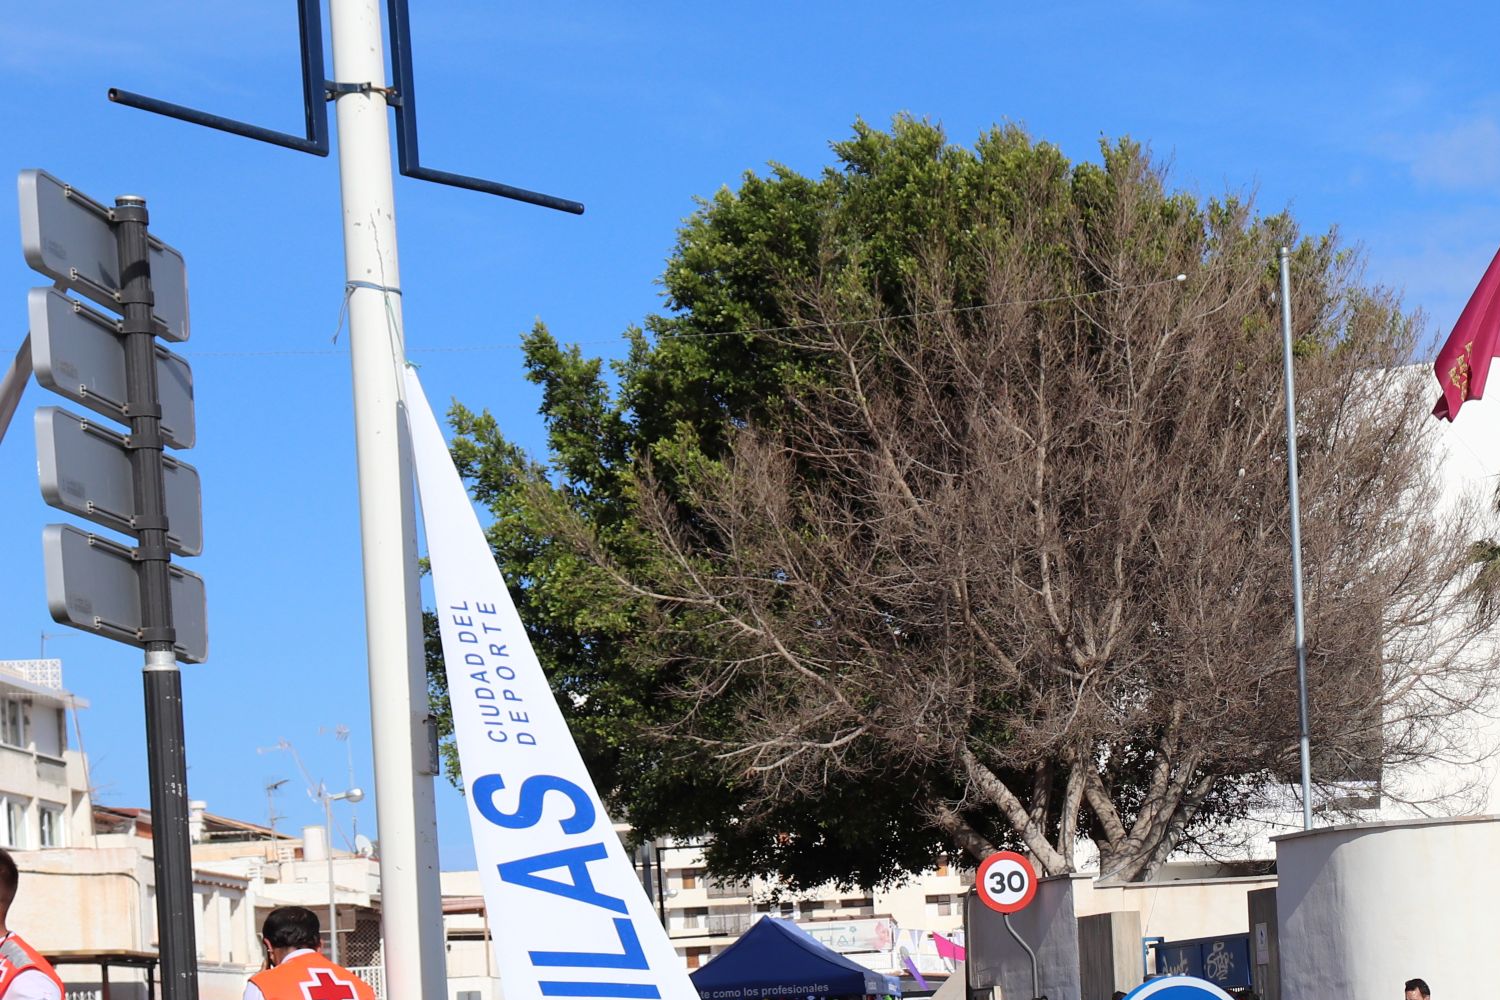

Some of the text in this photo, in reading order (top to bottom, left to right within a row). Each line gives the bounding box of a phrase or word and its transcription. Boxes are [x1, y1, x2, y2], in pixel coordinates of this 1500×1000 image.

[450, 600, 508, 743] CIUDAD DEL
[476, 602, 537, 746] DEPORTE
[990, 870, 1026, 894] 30
[713, 989, 741, 998] como
[743, 987, 759, 997] los
[761, 983, 830, 997] profesionales
